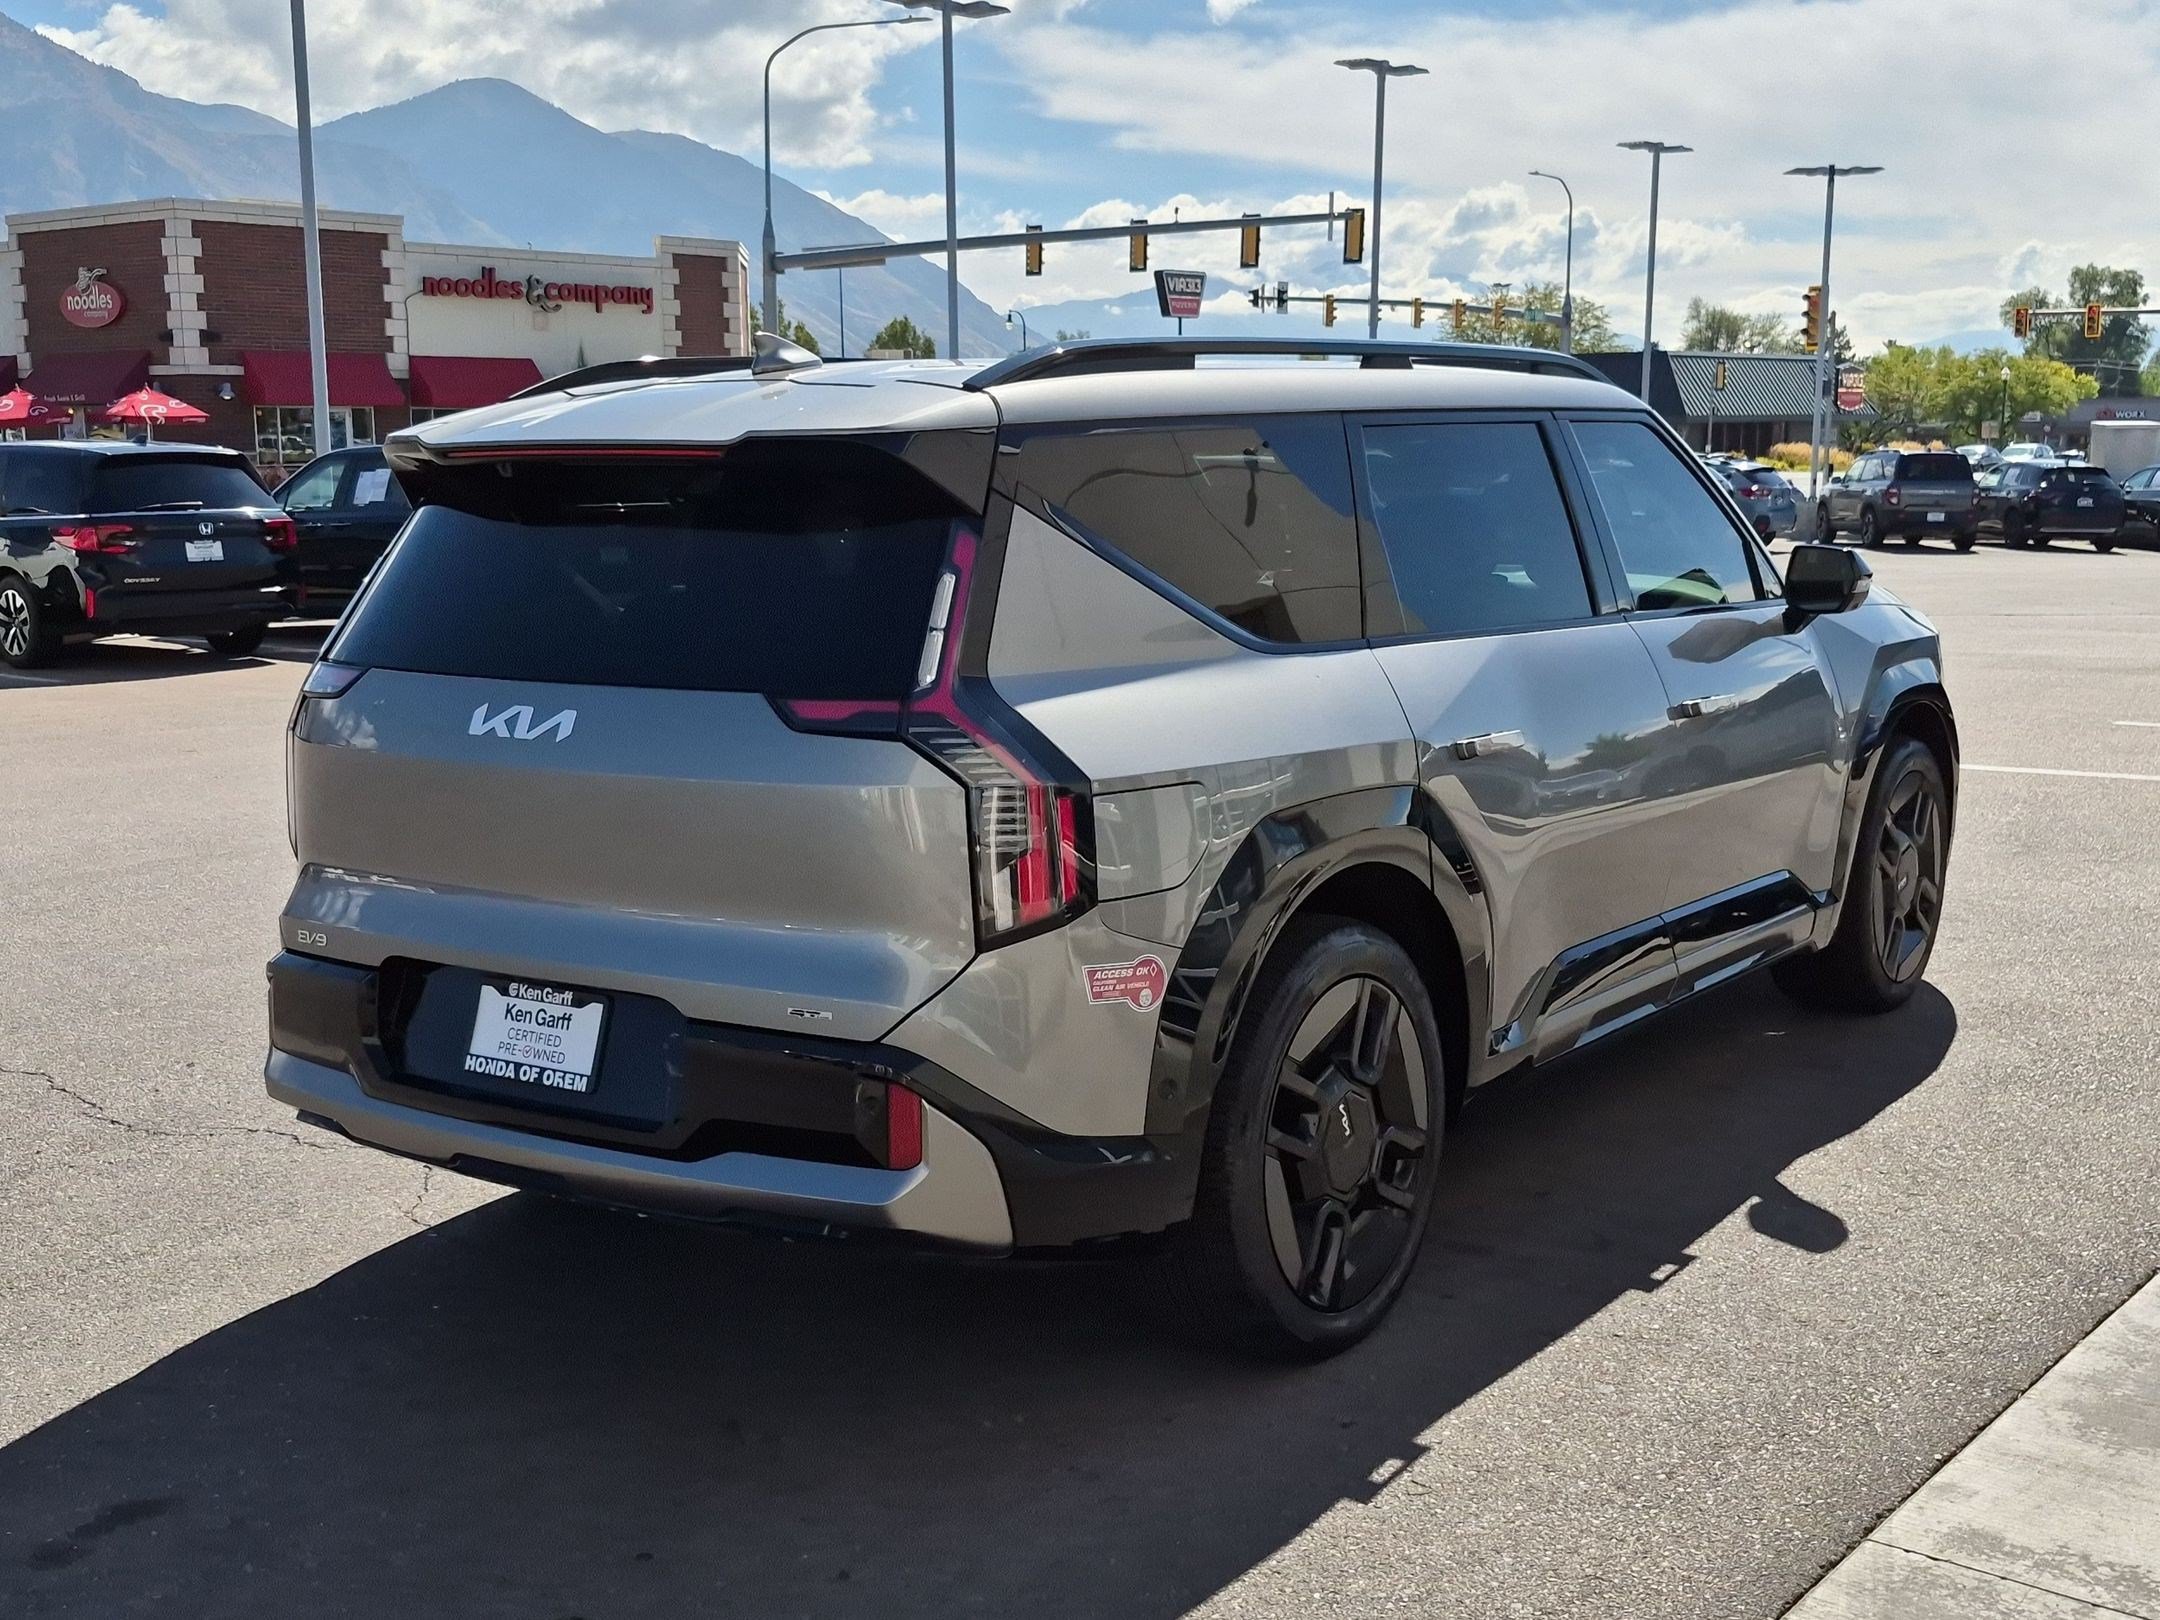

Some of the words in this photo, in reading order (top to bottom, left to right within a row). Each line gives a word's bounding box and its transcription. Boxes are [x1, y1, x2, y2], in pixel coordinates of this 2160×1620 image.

[422, 266, 524, 299] noodles
[525, 273, 562, 312] &
[66, 284, 113, 311] noodles
[543, 281, 654, 314] company
[1092, 984, 1114, 992] CLEAN
[1127, 981, 1150, 989] VEHICLE
[1093, 968, 1134, 980] ACCESS
[1136, 966, 1150, 976] OK
[519, 983, 542, 1001] Ken
[542, 988, 574, 1006] Garff
[504, 1002, 532, 1025] Ken
[535, 1008, 573, 1031] Garff
[507, 1027, 562, 1048] CERTIFIED
[464, 1055, 516, 1080] HONDA
[519, 1063, 541, 1083] OF
[542, 1069, 588, 1092] OREM
